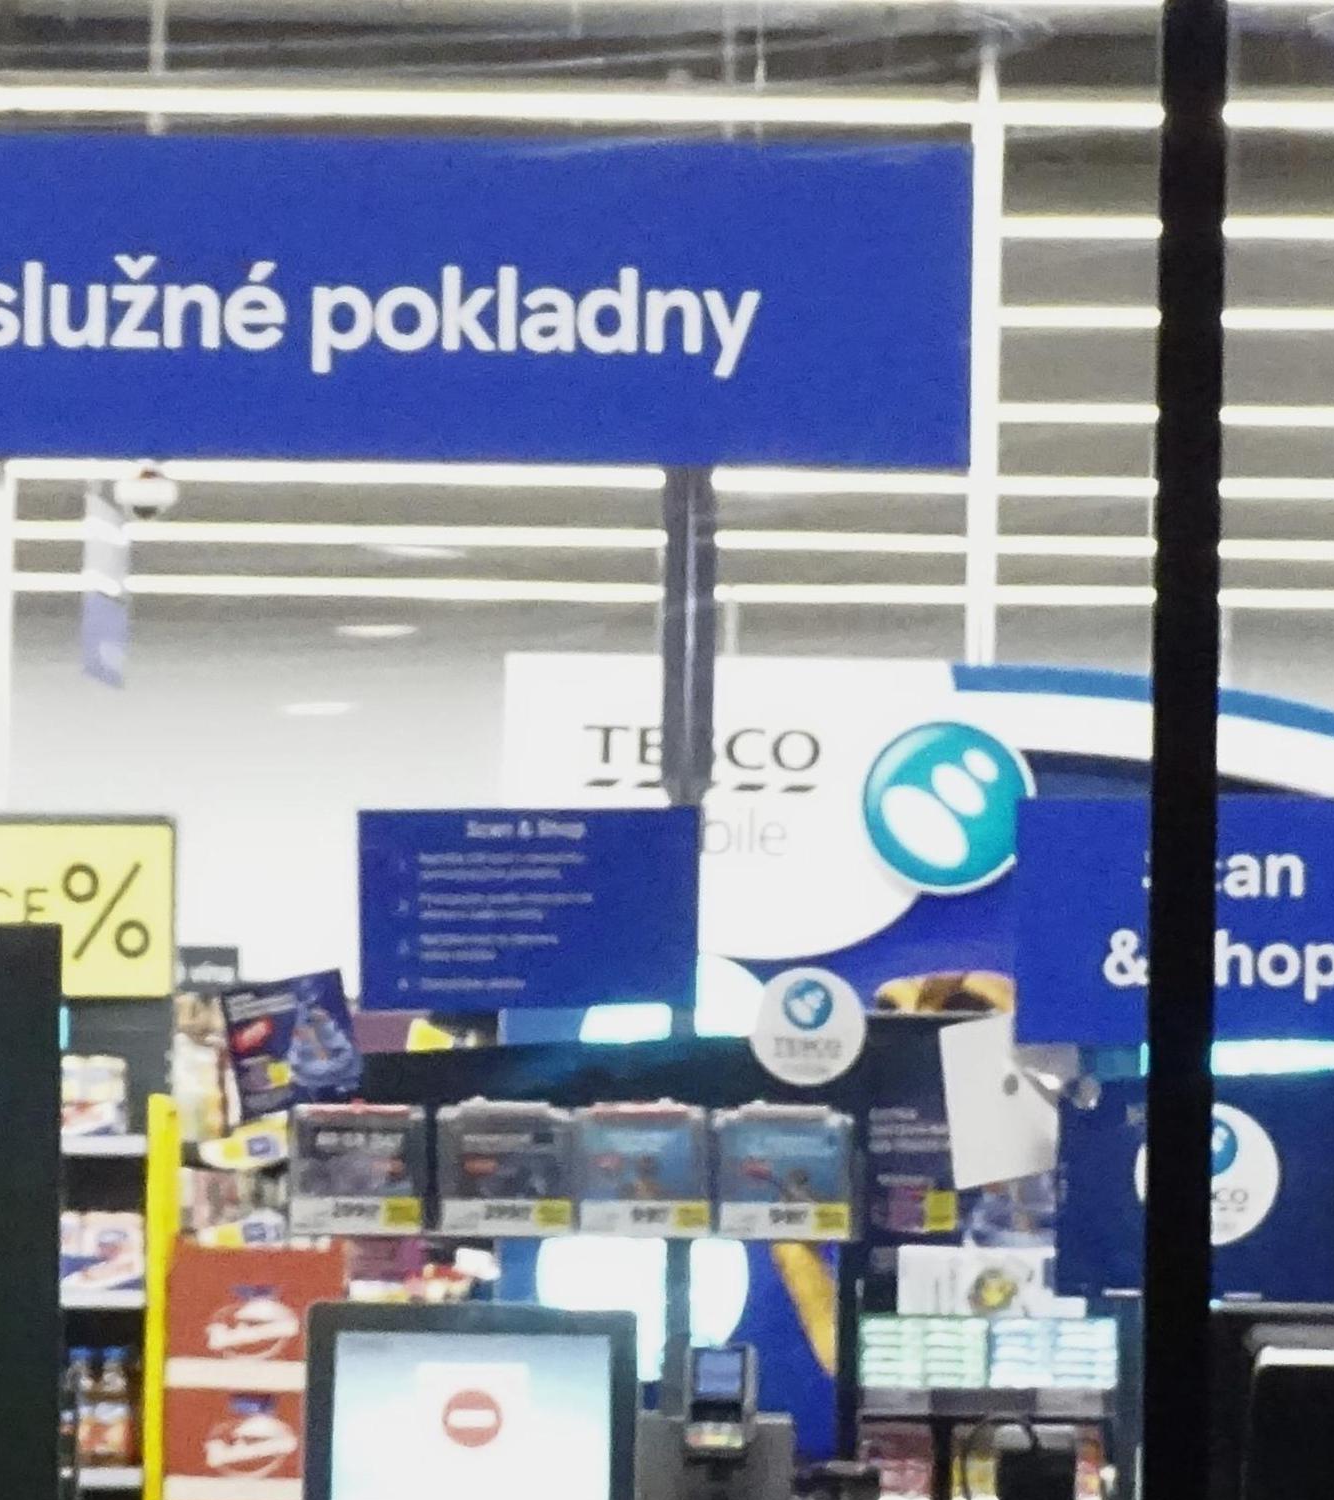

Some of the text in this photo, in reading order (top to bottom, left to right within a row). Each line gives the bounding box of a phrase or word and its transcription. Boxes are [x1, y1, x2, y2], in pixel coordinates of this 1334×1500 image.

[310, 264, 761, 379] pokladny
[584, 724, 821, 772] TECO
[1102, 928, 1150, 988] &
